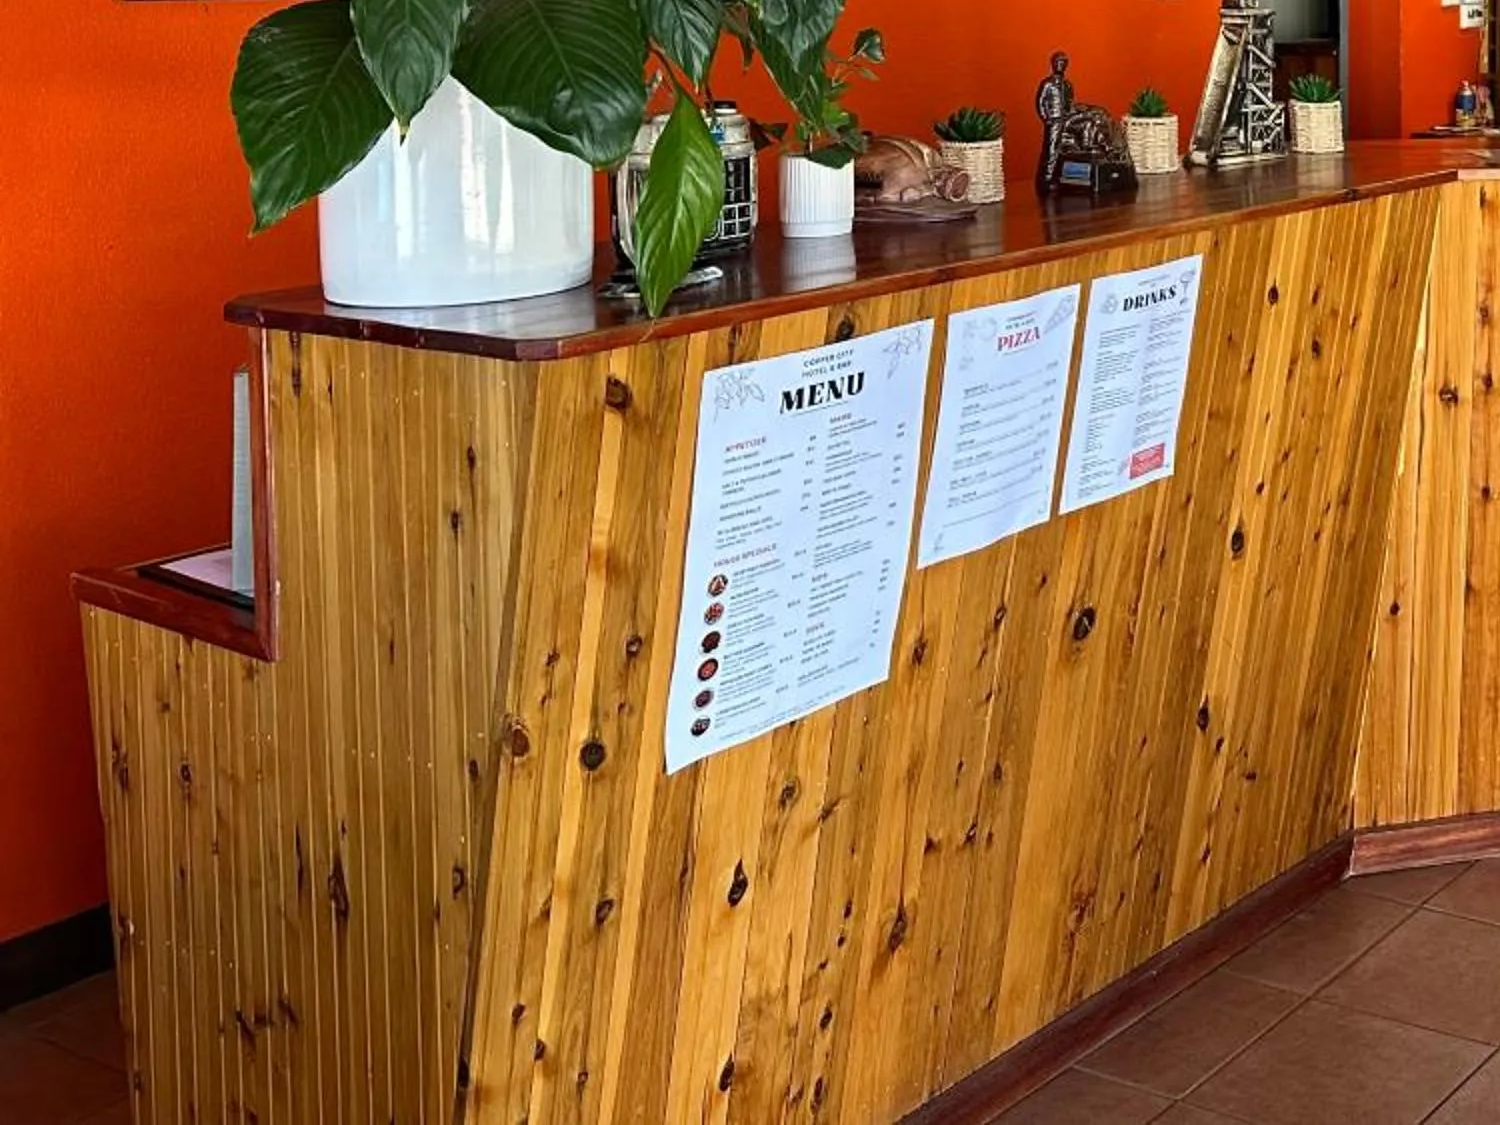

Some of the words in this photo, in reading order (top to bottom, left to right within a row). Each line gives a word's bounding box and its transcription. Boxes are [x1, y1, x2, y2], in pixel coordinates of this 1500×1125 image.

[1122, 284, 1178, 311] DRINKS
[997, 326, 1040, 351] PIZZA
[779, 371, 865, 414] MENU
